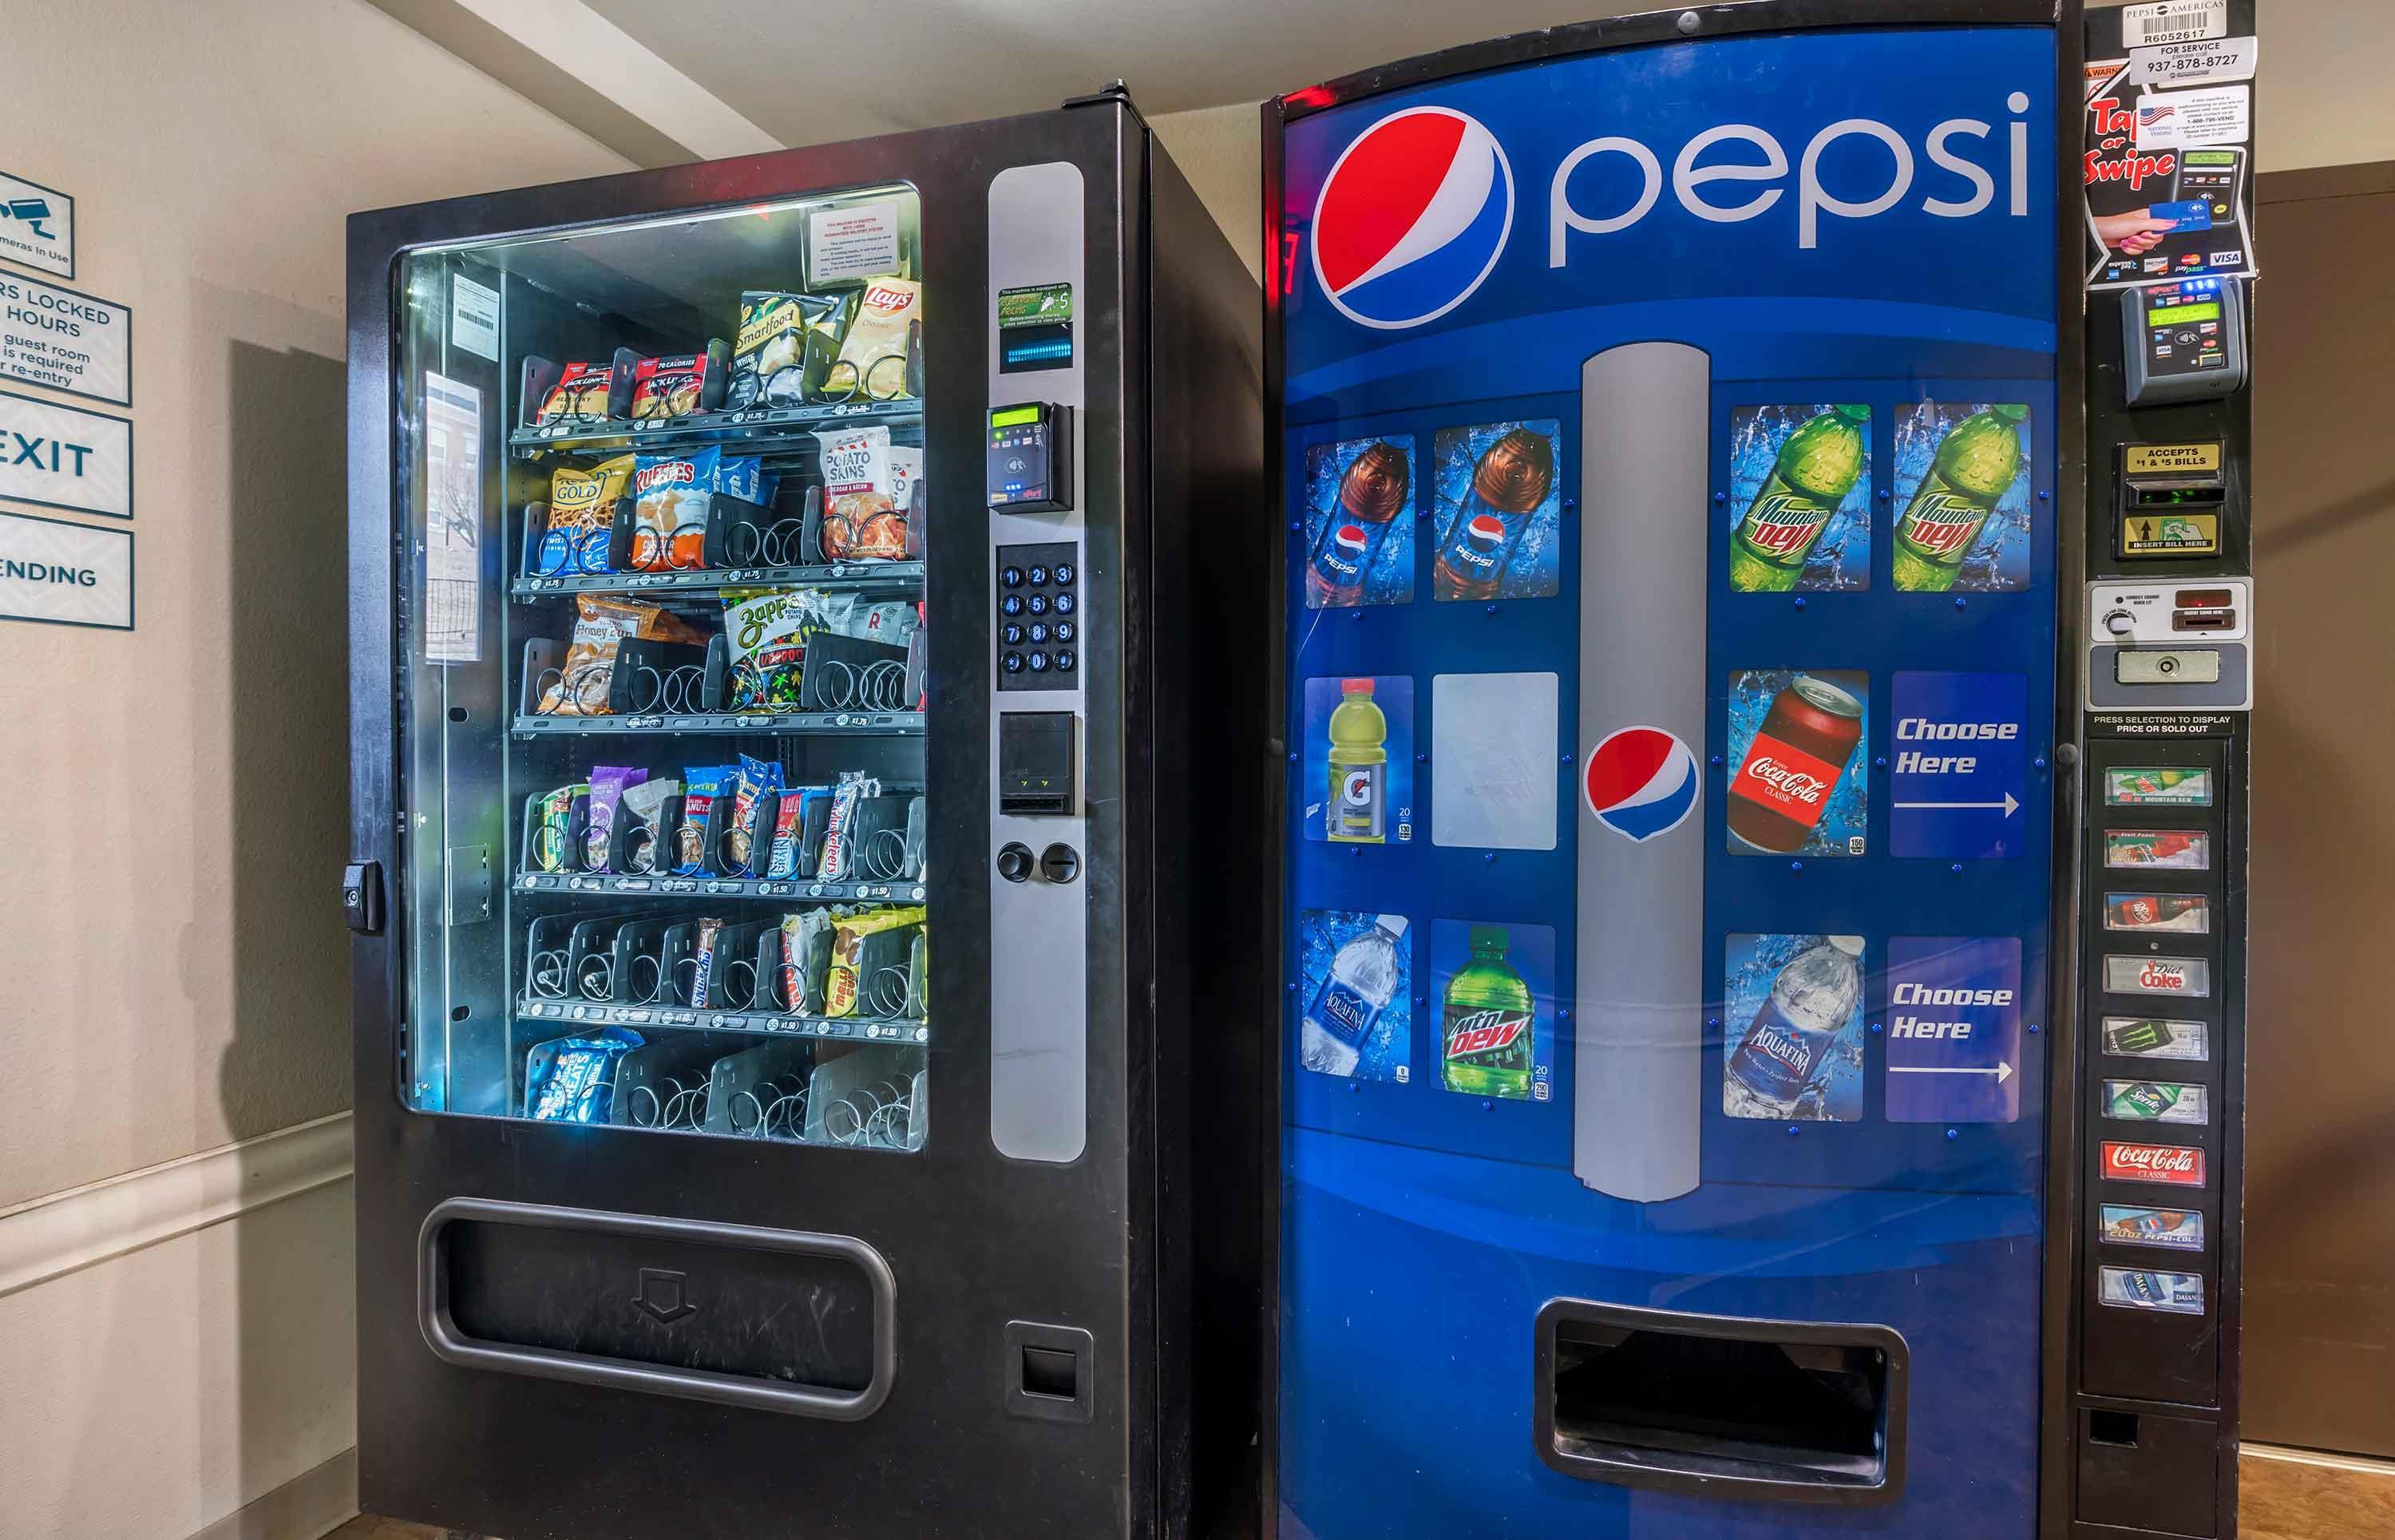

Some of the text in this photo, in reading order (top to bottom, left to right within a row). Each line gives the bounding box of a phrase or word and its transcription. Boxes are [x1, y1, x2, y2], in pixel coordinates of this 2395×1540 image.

[2126, 1, 2225, 18] PEPSI AMERICAS
[2144, 30, 2205, 44] R6052617
[2160, 42, 2220, 55] FOR SERVICE
[2148, 54, 2239, 72] 937-878-8727
[2101, 137, 2126, 149] or
[2084, 148, 2175, 191] Swipe
[1550, 91, 2029, 269] pepsi
[35, 246, 46, 256] In
[49, 250, 69, 263] Use
[2214, 254, 2240, 263] VISA
[27, 290, 110, 325] LOCKED
[7, 306, 81, 337] HOURS
[735, 310, 794, 350] Smartfood
[5, 335, 90, 363] guest room
[4, 346, 83, 374] is required
[11, 363, 72, 386] re-entry
[826, 451, 870, 467] POTATO
[2148, 448, 2199, 457] ACCEPTS
[829, 465, 865, 480] SKINS
[556, 485, 597, 499] GOLD
[1753, 496, 1827, 524] Mountain
[1913, 494, 1985, 522] Mountain
[1324, 553, 1358, 575] PEPSI
[1455, 544, 1494, 568] PEPSI
[0, 559, 97, 587] NDING
[1007, 568, 1067, 583] 1 2 3
[1005, 596, 1067, 612] 4 5 6
[576, 624, 608, 639] Honey
[1007, 625, 1067, 641] 7 8 9
[1033, 654, 1041, 668] 0
[1896, 718, 2019, 740] Choose
[1895, 752, 1977, 774] Here
[1342, 770, 1371, 806] G
[1764, 786, 1794, 805] CLASSIC
[1399, 808, 1411, 817] 20
[2158, 964, 2183, 974] Diet
[2140, 971, 2182, 988] Coke
[1893, 983, 2013, 1006] Choose
[1323, 990, 1366, 1031] AQUAFINA
[1891, 1016, 1971, 1039] Here
[1749, 1023, 1811, 1076] AQUAFINA
[1535, 1065, 1547, 1075] 20
[2138, 1170, 2170, 1179] CLASSIC
